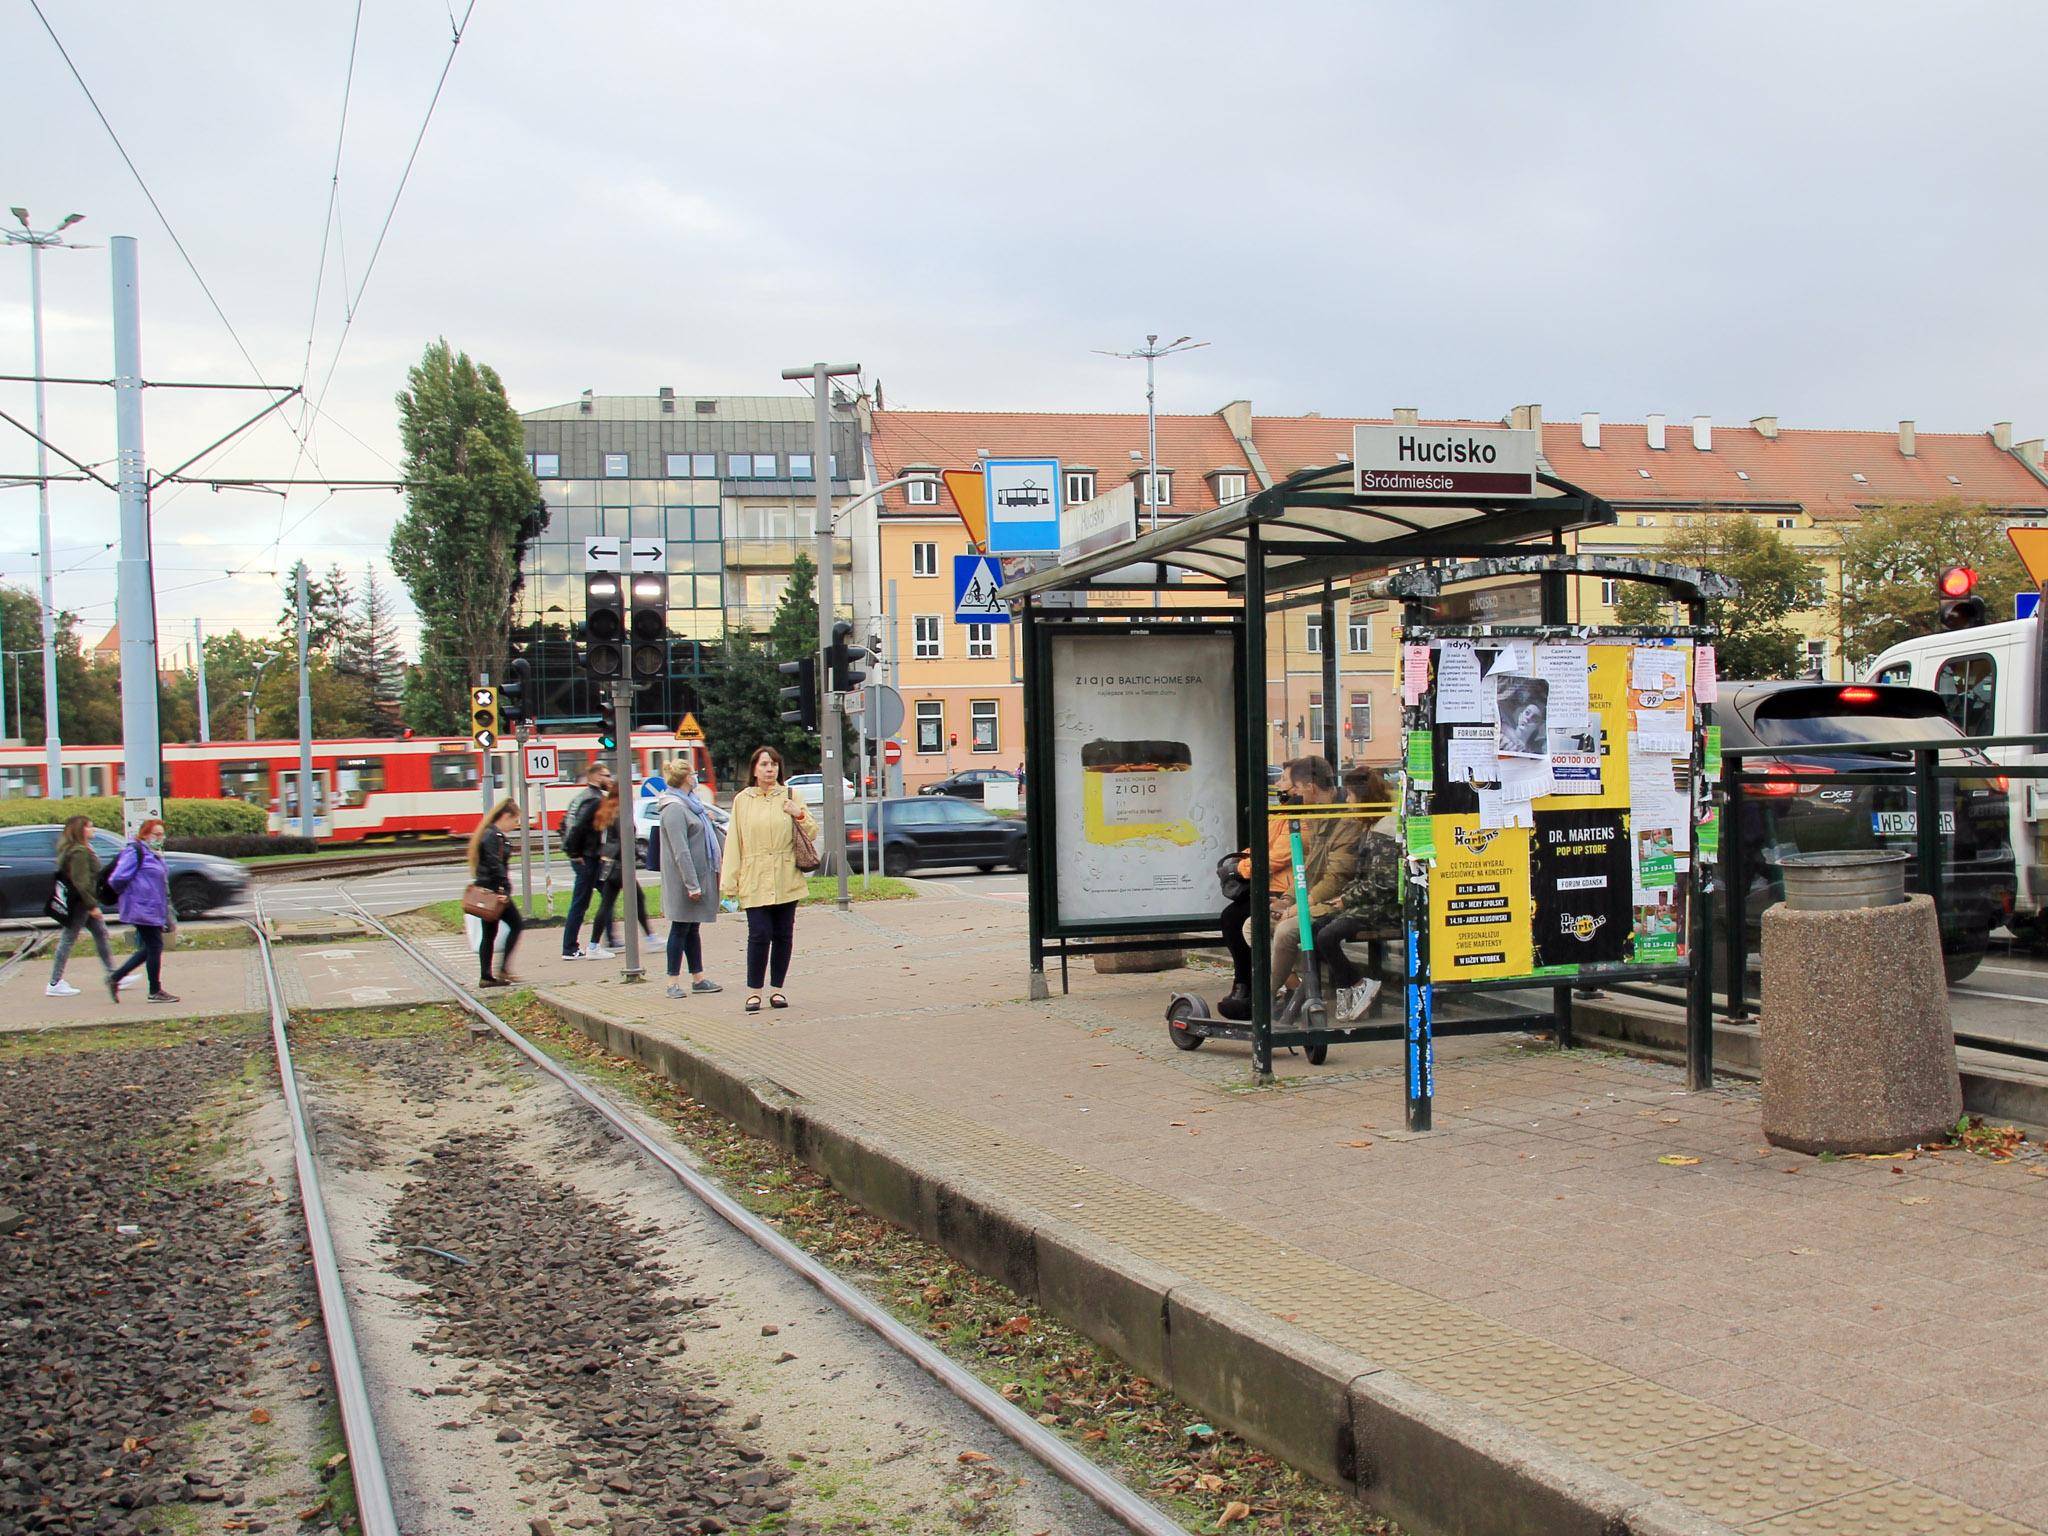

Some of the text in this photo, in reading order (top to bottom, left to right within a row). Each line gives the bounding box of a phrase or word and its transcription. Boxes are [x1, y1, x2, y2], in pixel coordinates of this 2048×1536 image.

[1399, 436, 1496, 463] Hucisko
[1364, 471, 1453, 489] Śródmieście
[1119, 676, 1151, 684] BALTIC
[1154, 676, 1182, 684] HOME
[1185, 676, 1202, 684] SPA
[534, 756, 549, 768] 10
[1820, 790, 1853, 798] CX-5
[1881, 814, 1903, 831] WB
[1455, 830, 1499, 845] Martens
[1549, 827, 1615, 843] DR. MARTENS
[1556, 844, 1607, 856] POP UP STORE
[1561, 880, 1580, 888] FORUM
[1561, 915, 1607, 933] Martens
